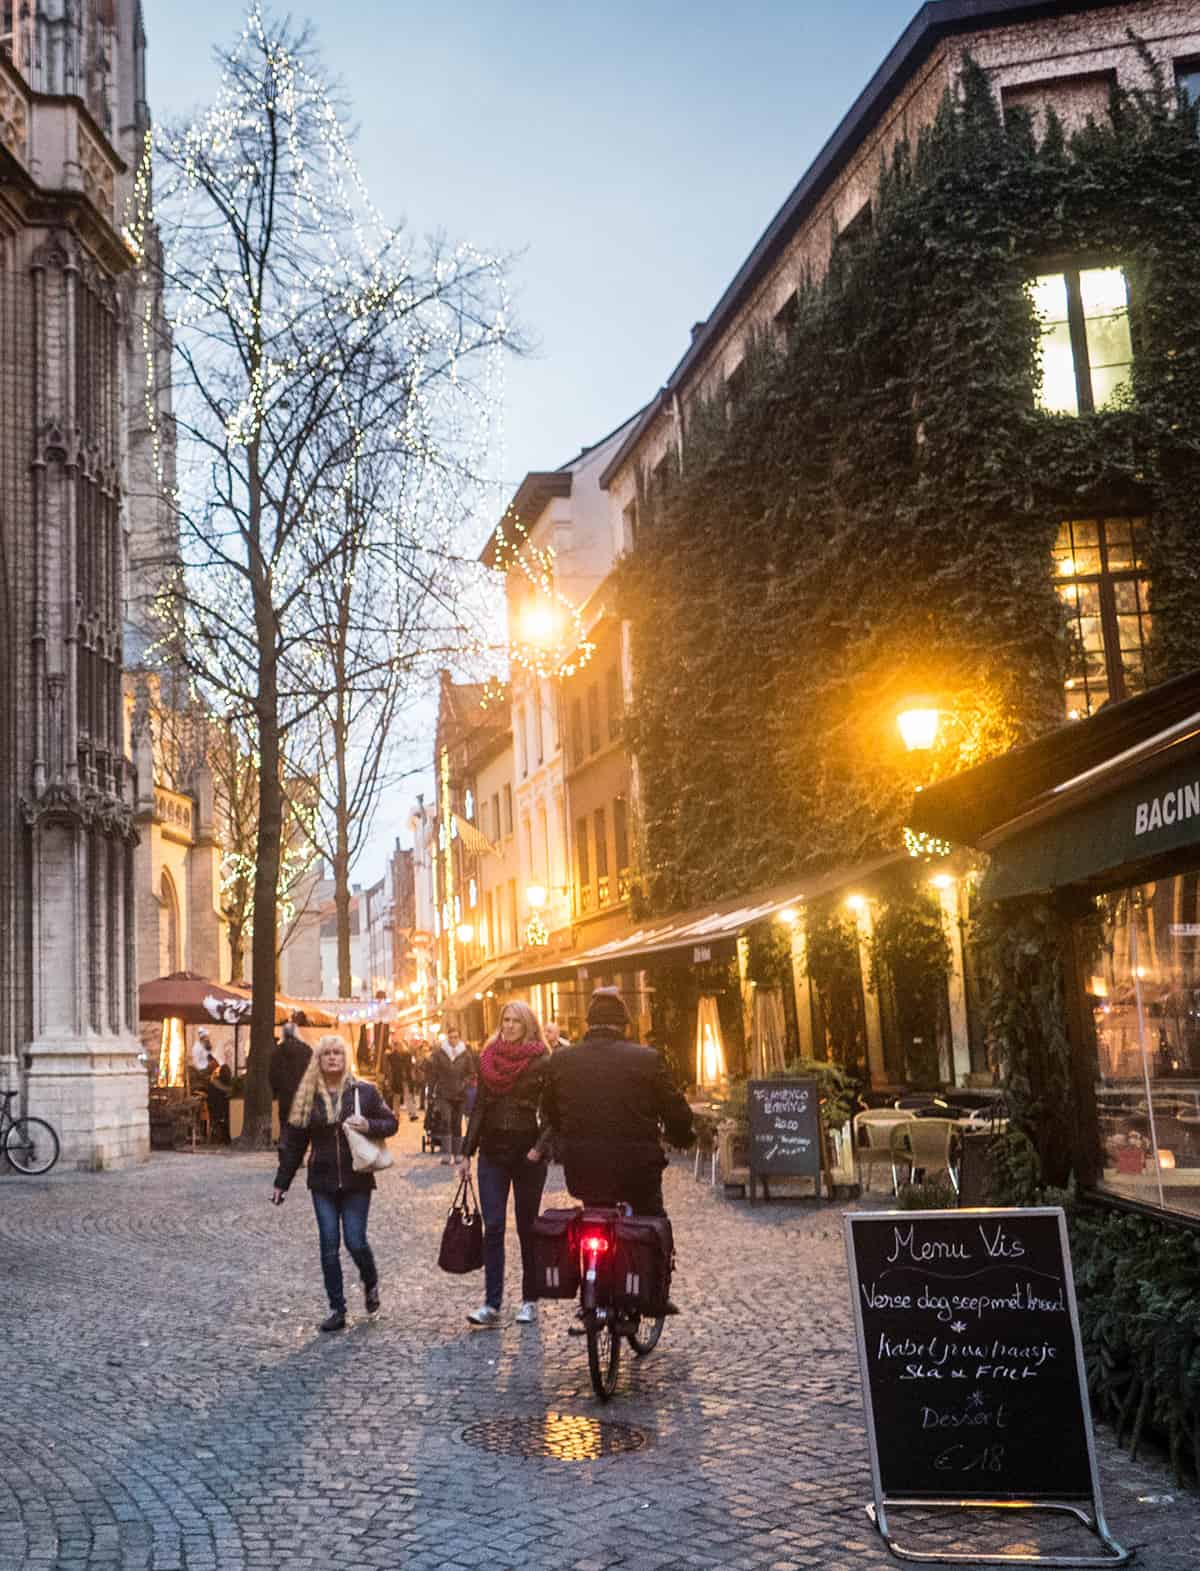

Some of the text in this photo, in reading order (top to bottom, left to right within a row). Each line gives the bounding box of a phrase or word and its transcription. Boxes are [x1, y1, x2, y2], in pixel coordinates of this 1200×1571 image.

[887, 1223, 1025, 1263] Menu Vis
[862, 1282, 912, 1310] Verse
